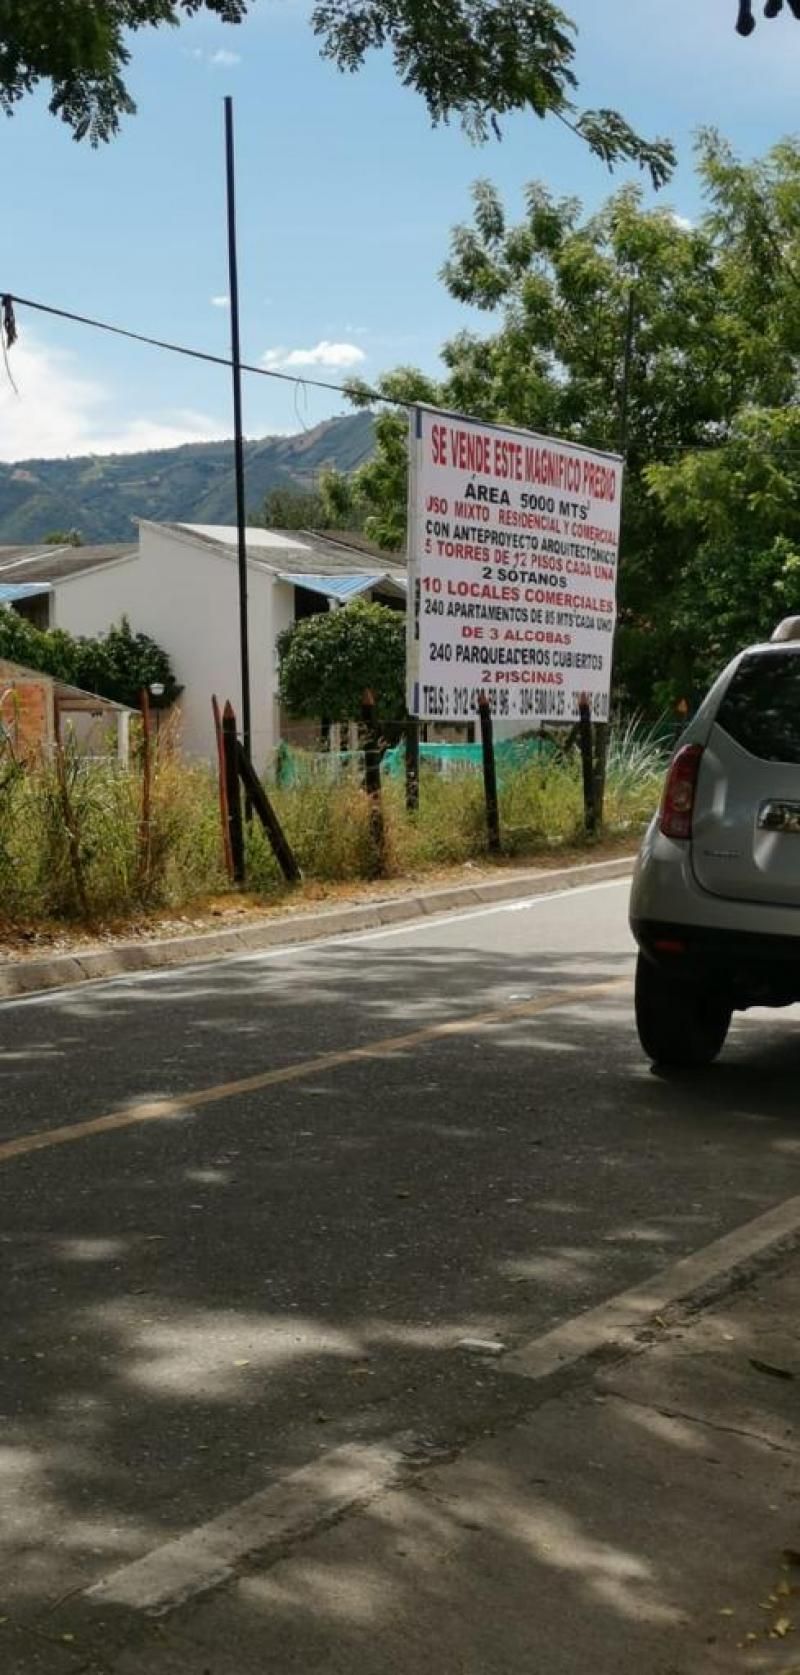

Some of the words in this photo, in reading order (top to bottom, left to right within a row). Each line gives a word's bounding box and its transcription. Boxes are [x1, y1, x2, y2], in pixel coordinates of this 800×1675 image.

[432, 424, 447, 466] SE
[451, 428, 491, 474] VENDE
[494, 439, 522, 481] ESTE
[525, 446, 580, 493] MAGNIFICO
[583, 460, 616, 502] PREDIO
[520, 493, 554, 513] 5000
[425, 519, 449, 538] CON
[453, 524, 539, 549] ANTEPROYECTO
[426, 496, 448, 515] USO
[454, 501, 490, 522] MIXTO
[499, 509, 561, 534] RESIDENCIAL
[563, 521, 570, 534] Y
[571, 523, 617, 545] COMERCIAL
[424, 538, 432, 554] 5
[437, 541, 490, 562] TORRES
[494, 550, 510, 565] DE
[513, 552, 526, 567] 12
[531, 555, 562, 572] PISOS
[565, 560, 592, 577] CADA
[594, 565, 614, 581] UNA
[482, 567, 492, 580] 2
[423, 577, 442, 593] 10
[447, 580, 520, 601] LOCALES
[524, 588, 614, 613] COMERCIALES
[424, 599, 444, 616] 240
[447, 602, 529, 623] APARTAMENTOS
[530, 609, 543, 624] DE
[575, 614, 595, 629] CADA
[597, 618, 613, 632] UNO
[462, 625, 483, 639] DE
[490, 627, 498, 640] 3
[504, 629, 572, 645] ALCOBAS
[429, 643, 452, 662] 240
[455, 645, 550, 667] PARQUEADEROS
[552, 651, 603, 671] CUBIERTOS
[482, 670, 491, 683] 2
[495, 671, 563, 685] PISCINAS
[453, 687, 468, 715] 312
